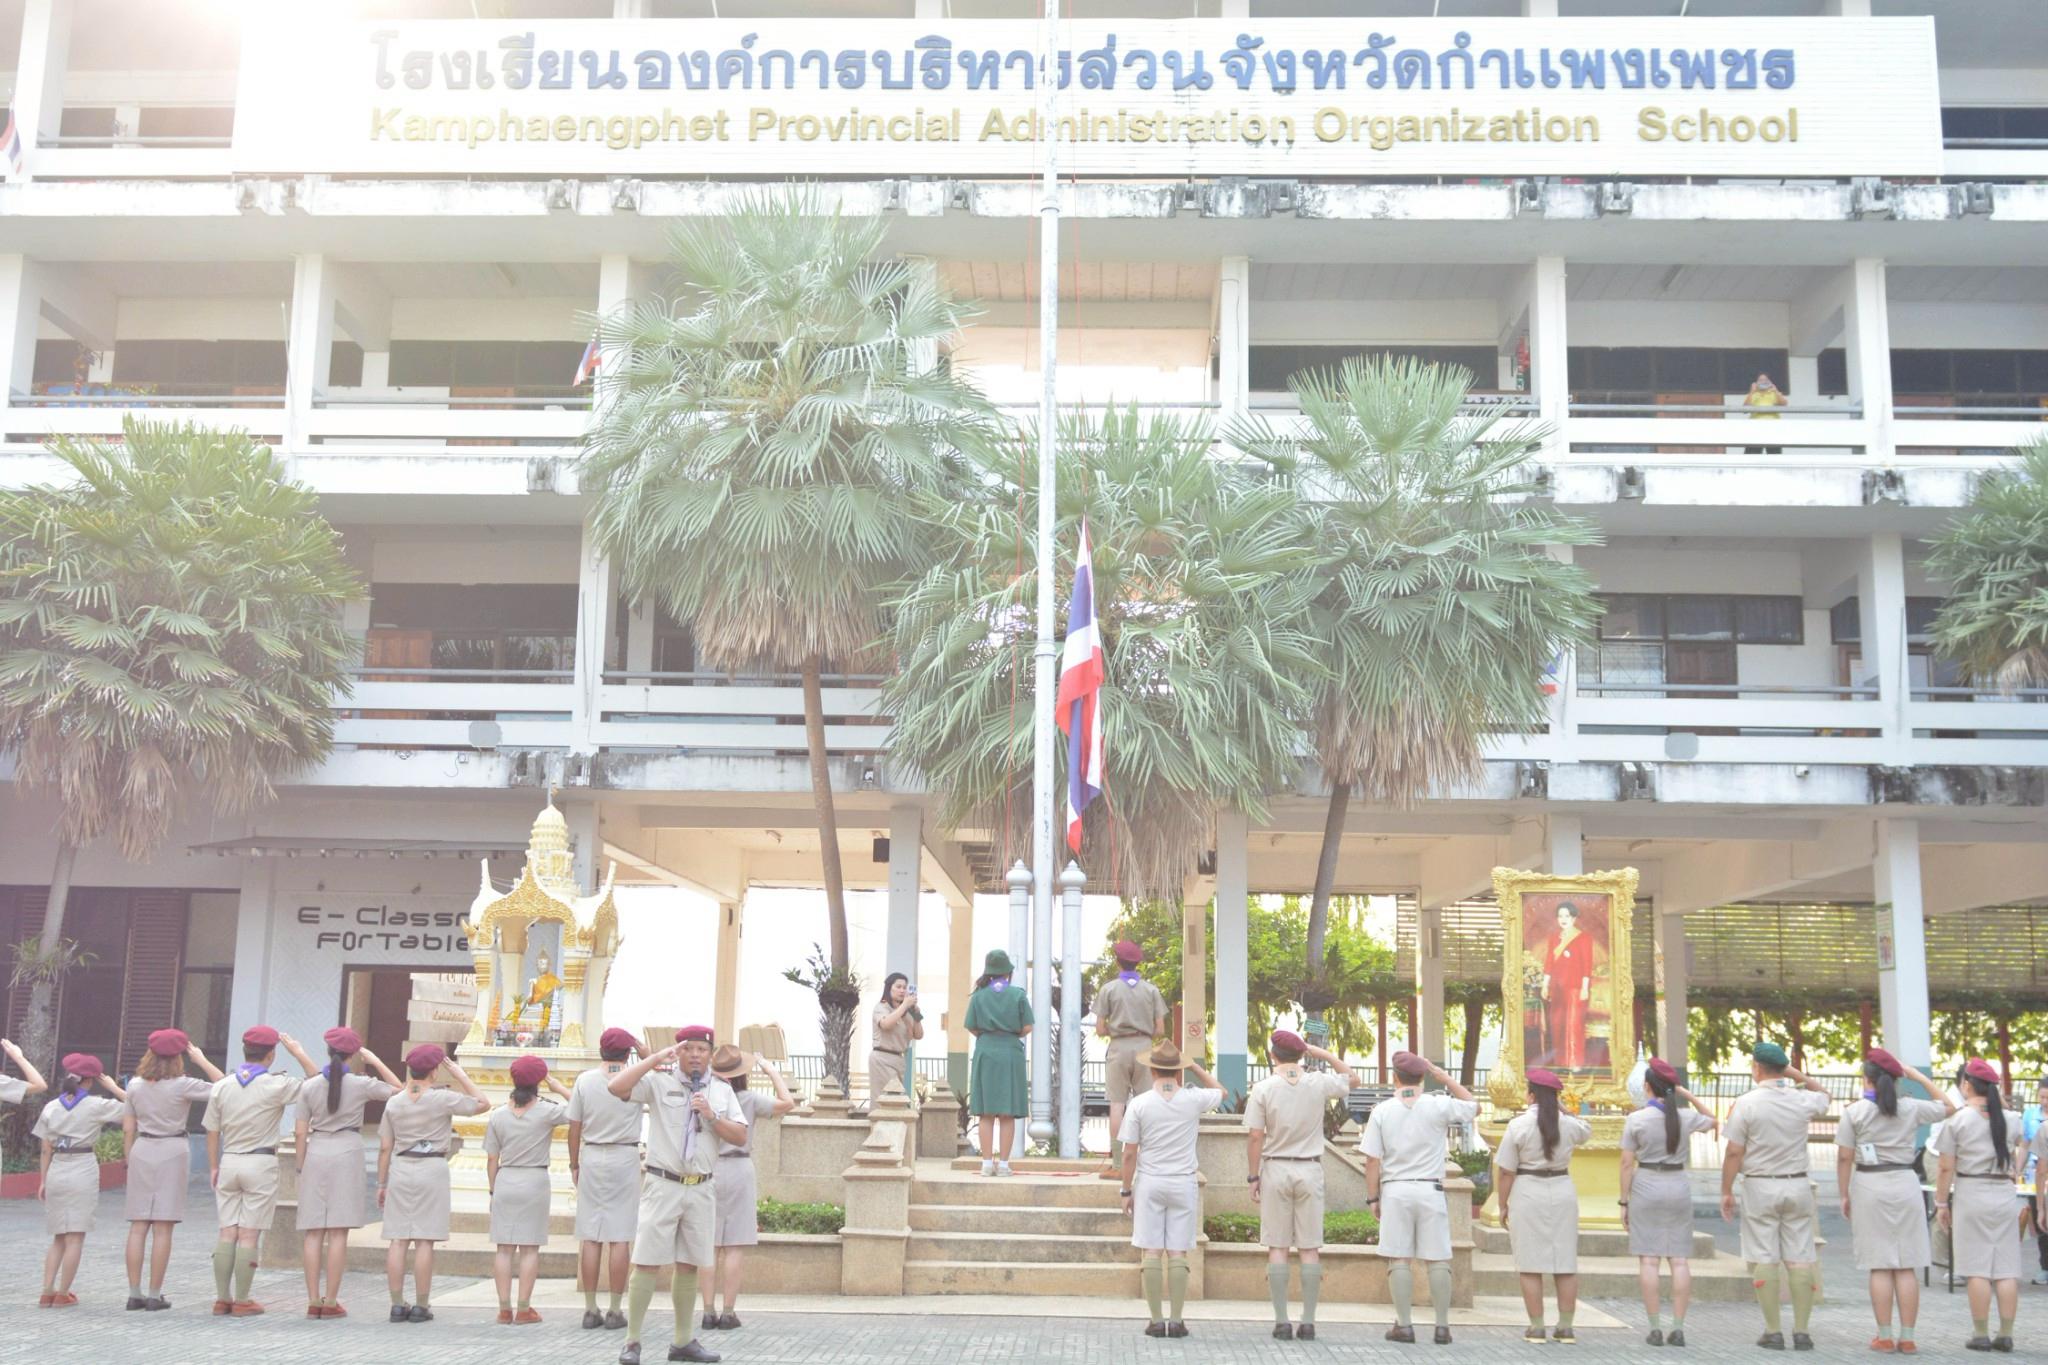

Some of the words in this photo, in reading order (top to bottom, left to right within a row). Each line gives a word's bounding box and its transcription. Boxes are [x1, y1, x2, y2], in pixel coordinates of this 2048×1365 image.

[369, 106, 730, 150] Kamphaengphet
[748, 106, 961, 143] Provincial
[978, 107, 1296, 143] Administration
[1313, 106, 1601, 151] Organization
[1637, 105, 1799, 143] School
